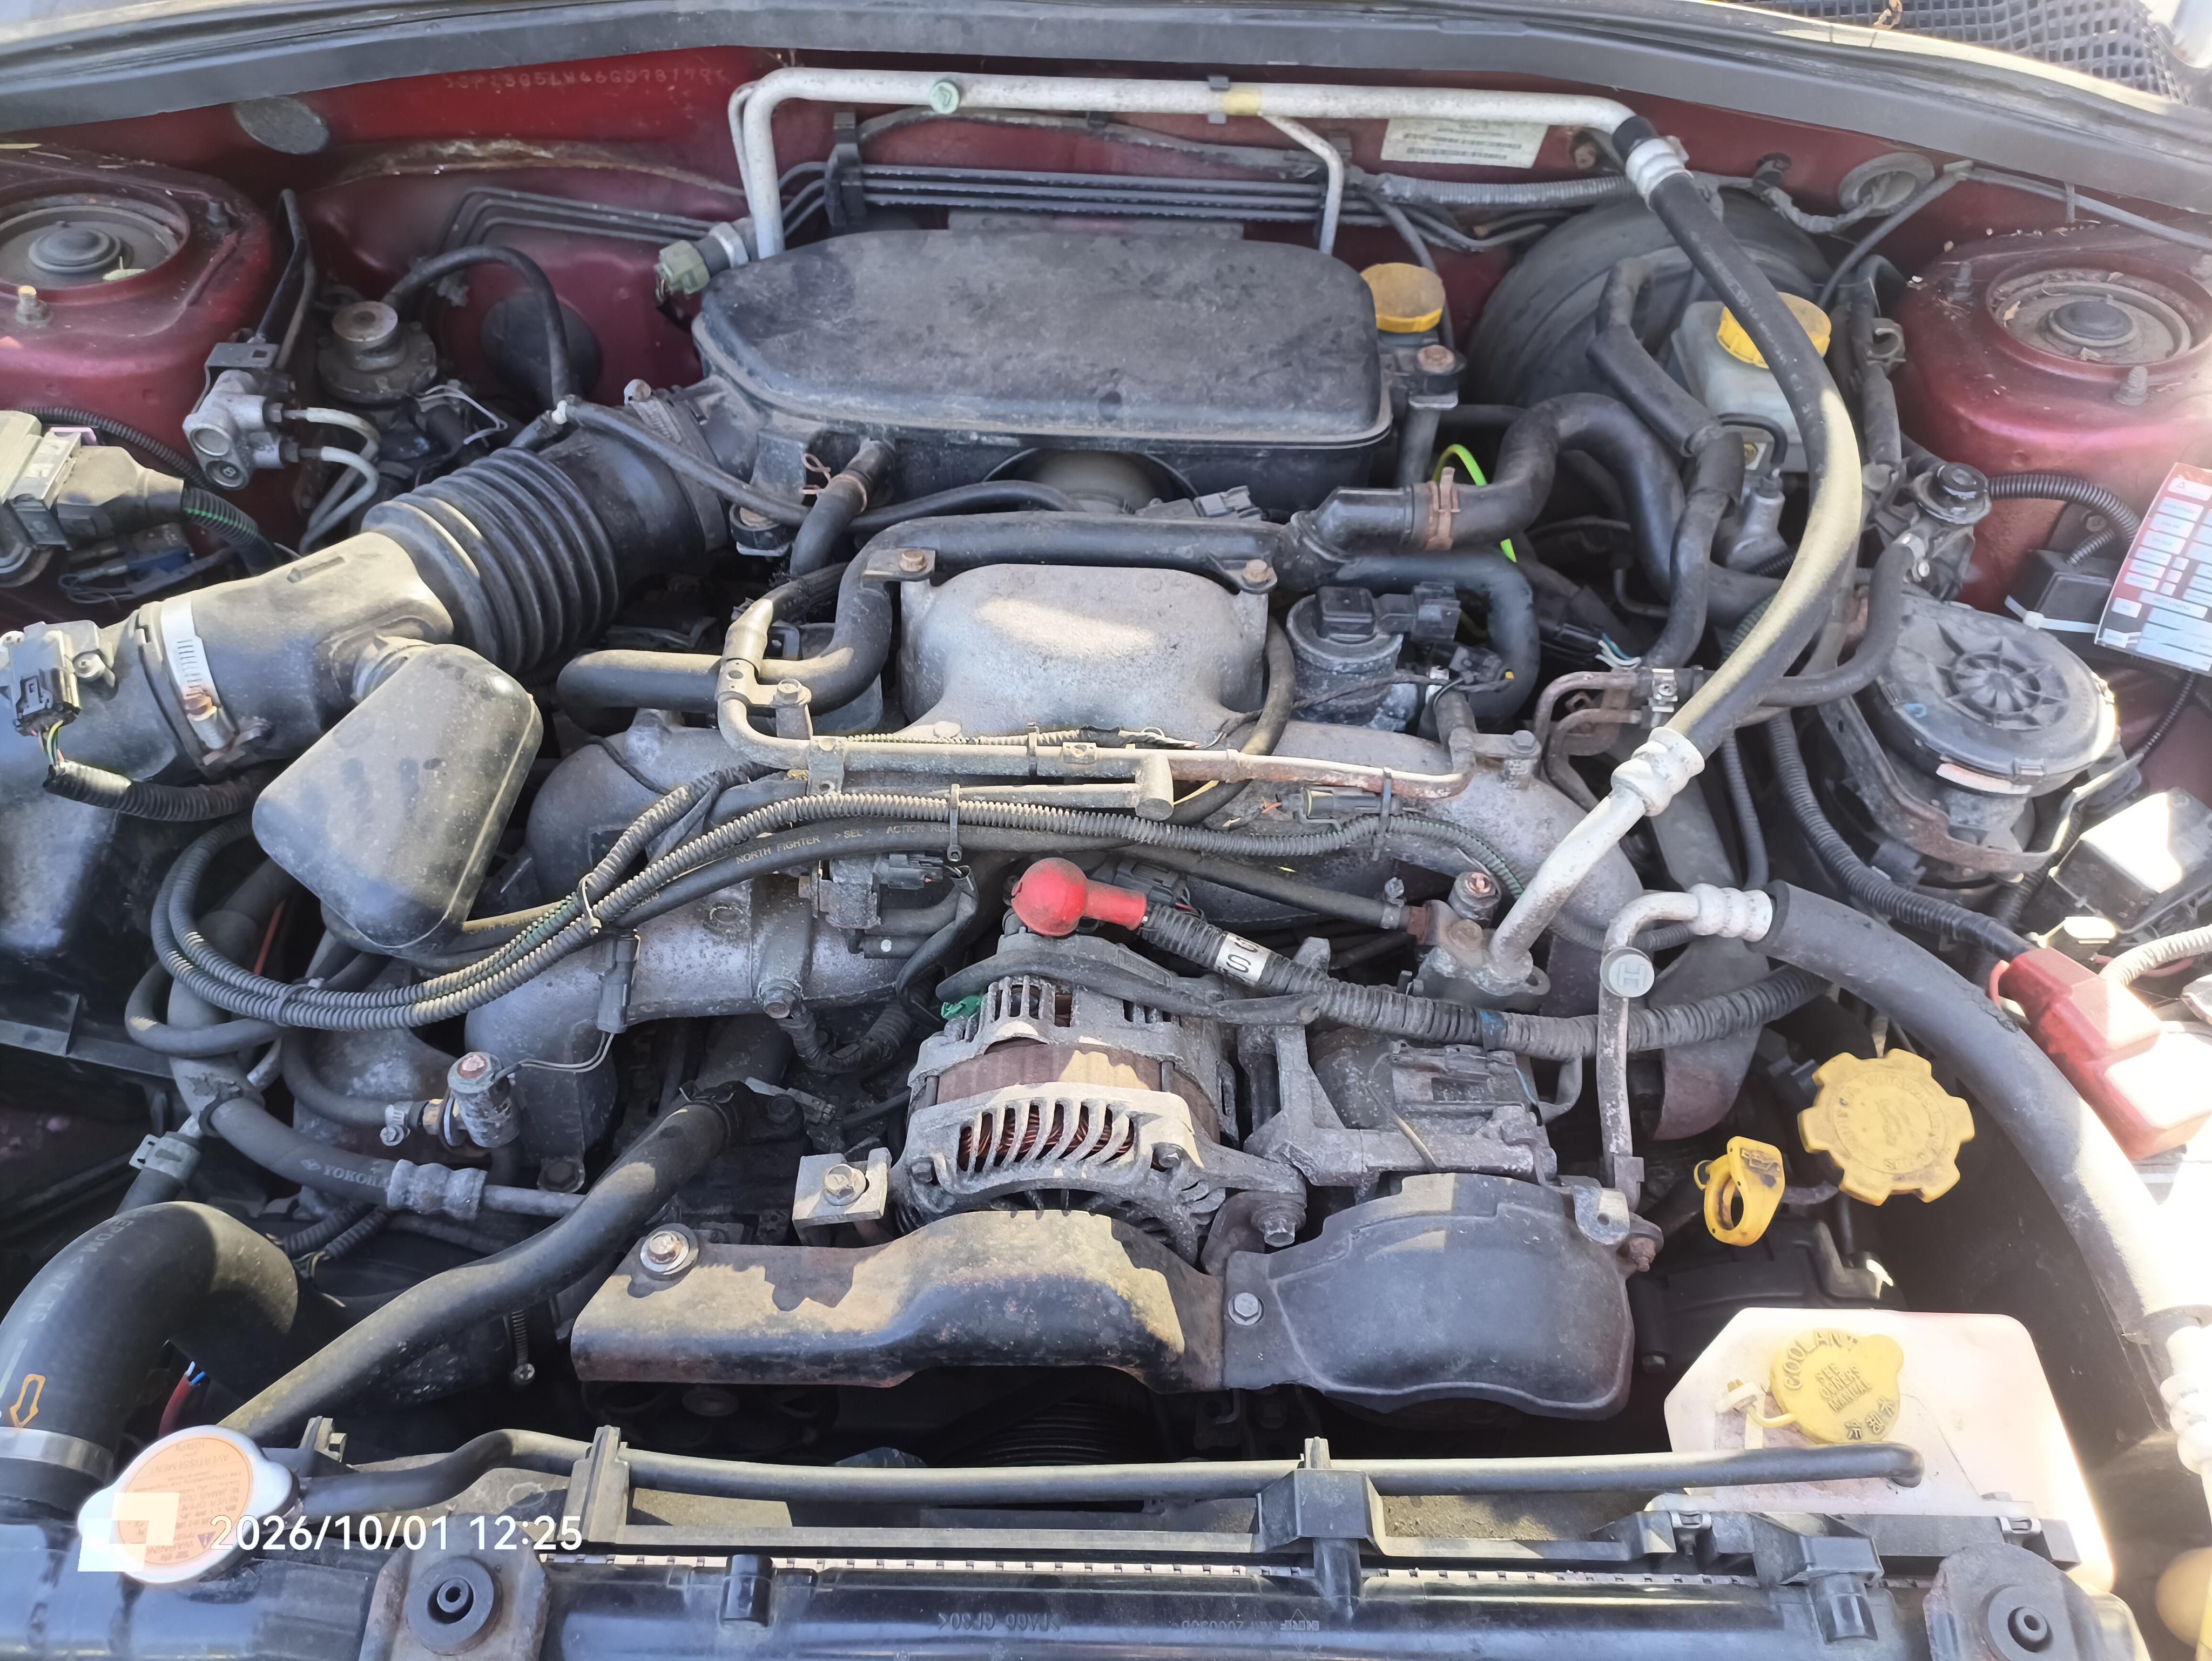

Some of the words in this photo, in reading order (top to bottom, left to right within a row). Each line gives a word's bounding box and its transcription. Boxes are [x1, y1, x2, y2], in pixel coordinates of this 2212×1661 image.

[735, 846, 772, 865] NORTH
[777, 835, 821, 853] FIGHTER
[1618, 962, 1646, 990] H
[1782, 1330, 1858, 1391] COOLANT
[1815, 1362, 1840, 1384] SEE
[1818, 1364, 1863, 1400] OWNERS
[1827, 1378, 1873, 1413] MANUAL
[148, 1453, 230, 1475] AVERTISSEMENT
[1280, 1619, 1320, 1631] NRF
